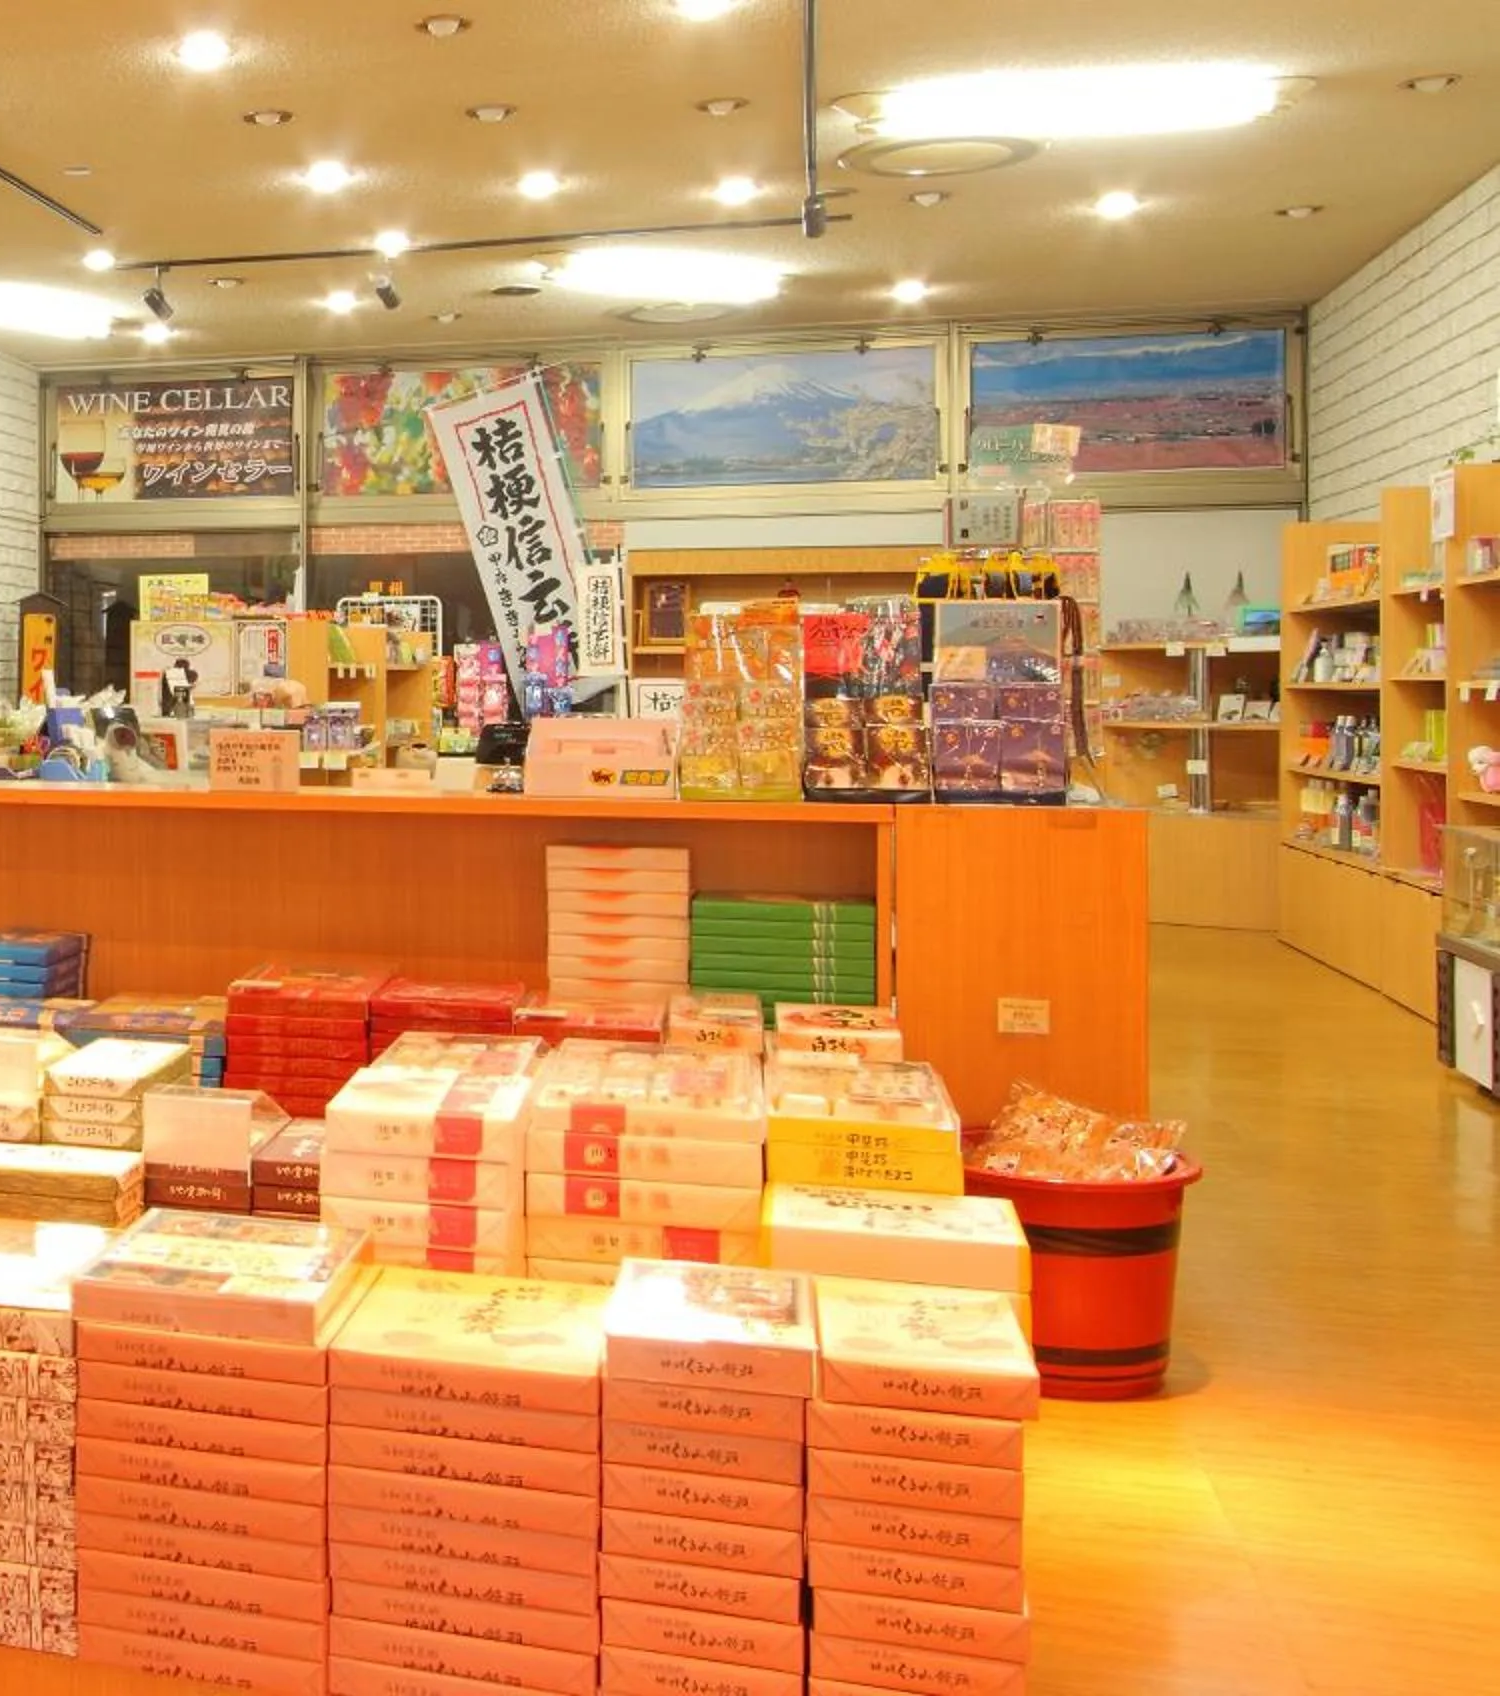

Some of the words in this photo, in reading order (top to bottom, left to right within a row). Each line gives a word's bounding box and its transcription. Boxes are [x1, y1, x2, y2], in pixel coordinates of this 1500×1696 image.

[67, 390, 151, 415] WINE
[159, 384, 292, 412] CELLAR
[143, 458, 293, 487] ワインセラー
[472, 417, 579, 671] 桔梗信玄
